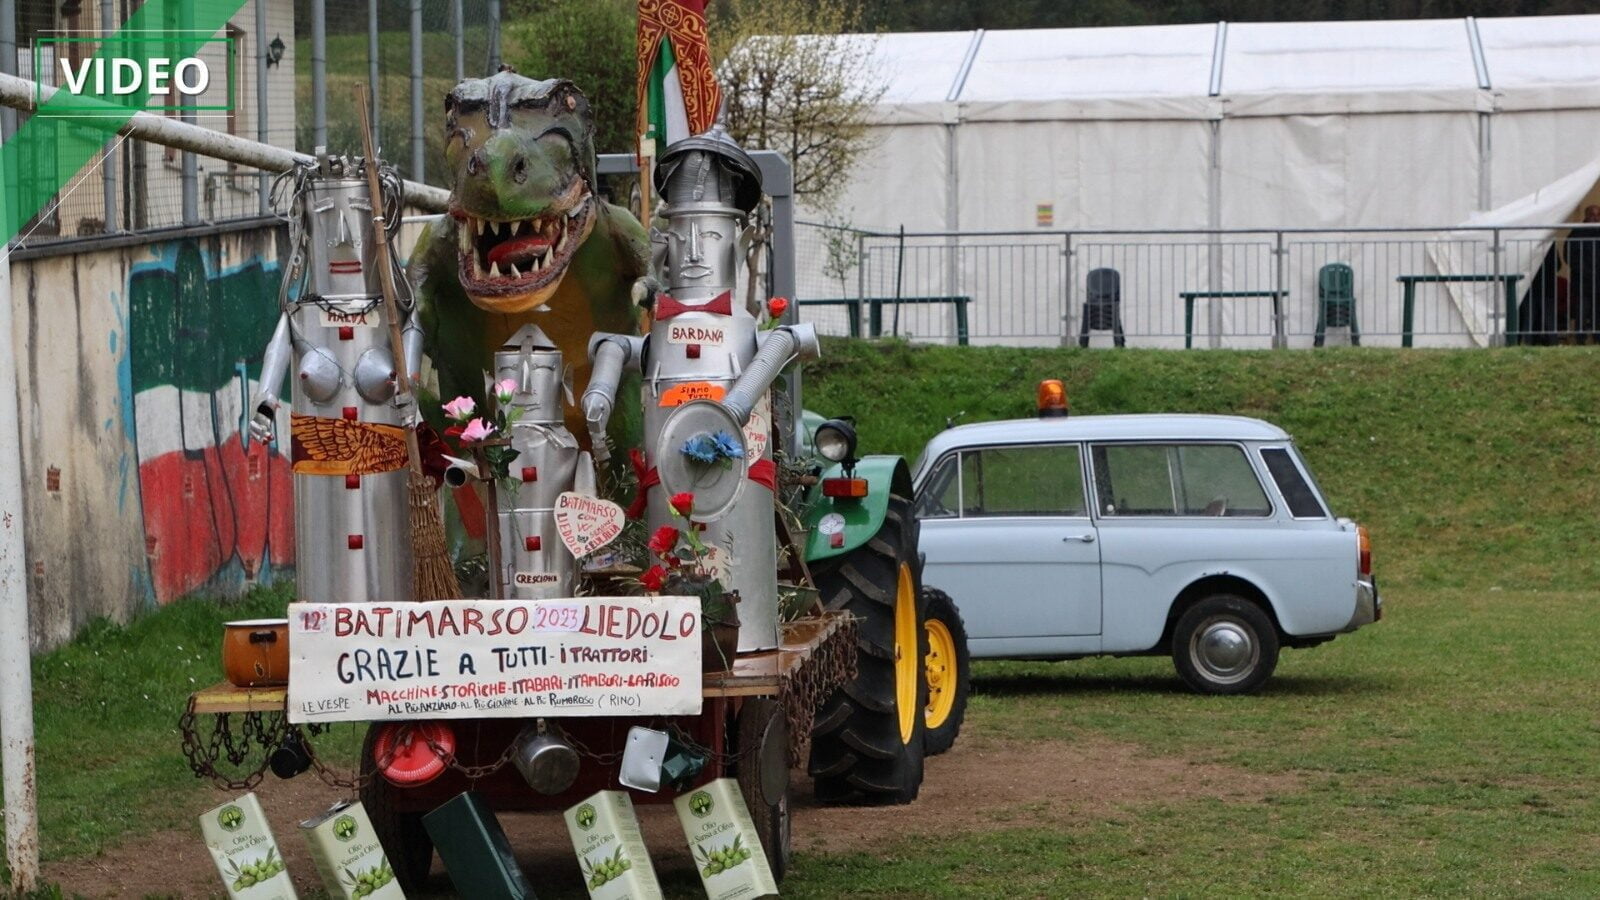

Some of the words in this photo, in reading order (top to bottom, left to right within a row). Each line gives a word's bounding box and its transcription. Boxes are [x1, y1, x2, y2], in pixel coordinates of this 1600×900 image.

[672, 327, 724, 343] BARDANA
[560, 495, 617, 518] BATIMARSO
[557, 513, 581, 554] LIEDOLO
[335, 606, 528, 638] BATIMARSO
[536, 607, 578, 629] 2023
[579, 605, 695, 640] LIEDOLO
[337, 646, 440, 684] GRAZIE
[459, 653, 477, 675] A
[302, 701, 316, 713] LE
[317, 697, 350, 711] VESPE
[388, 703, 403, 714] AL
[702, 822, 716, 832] Olio
[717, 822, 735, 833] Oliva
[232, 835, 248, 845] Olio
[587, 833, 600, 843] Olio
[348, 844, 363, 854] Olio
